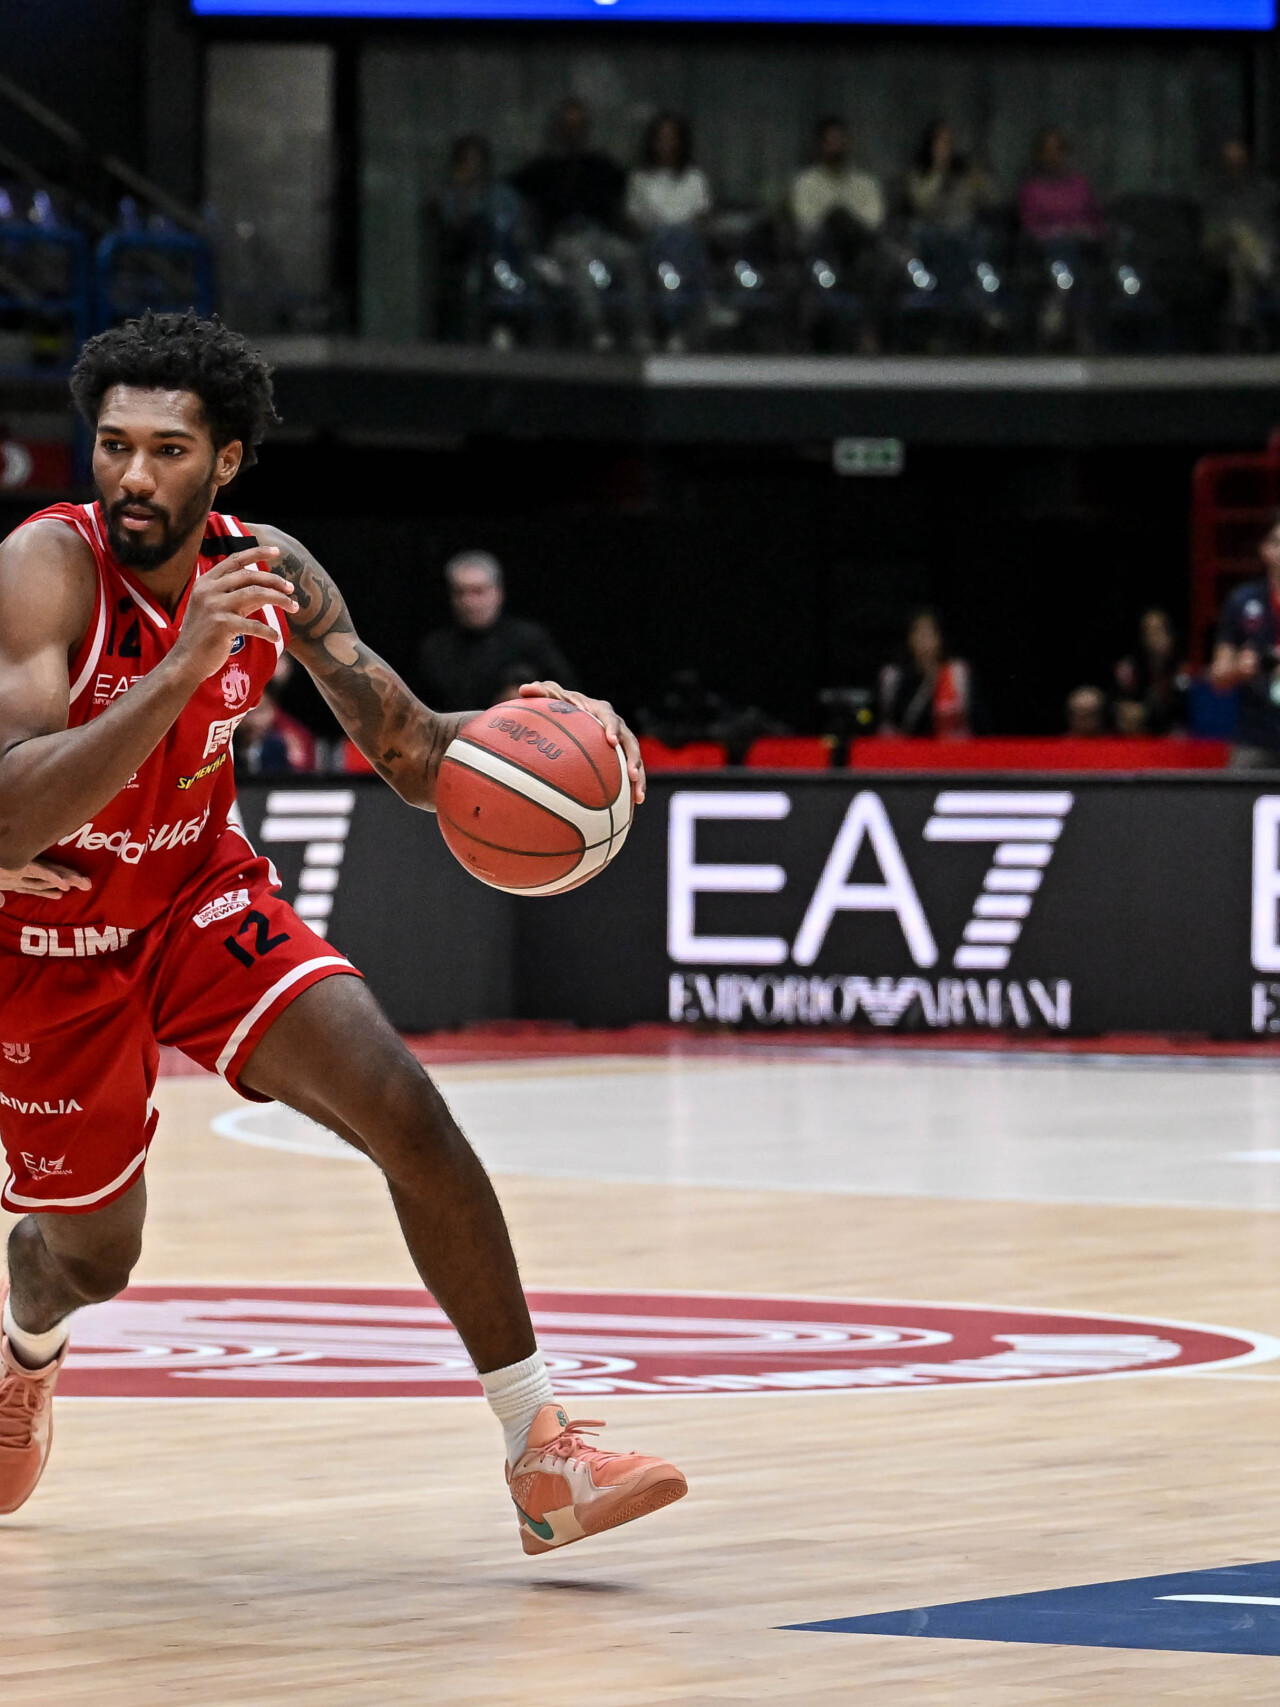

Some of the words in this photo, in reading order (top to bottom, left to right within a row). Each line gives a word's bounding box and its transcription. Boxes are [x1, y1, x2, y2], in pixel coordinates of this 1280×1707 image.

[487, 715, 563, 760] molten
[667, 790, 1075, 969] EA7
[223, 911, 291, 969] 12
